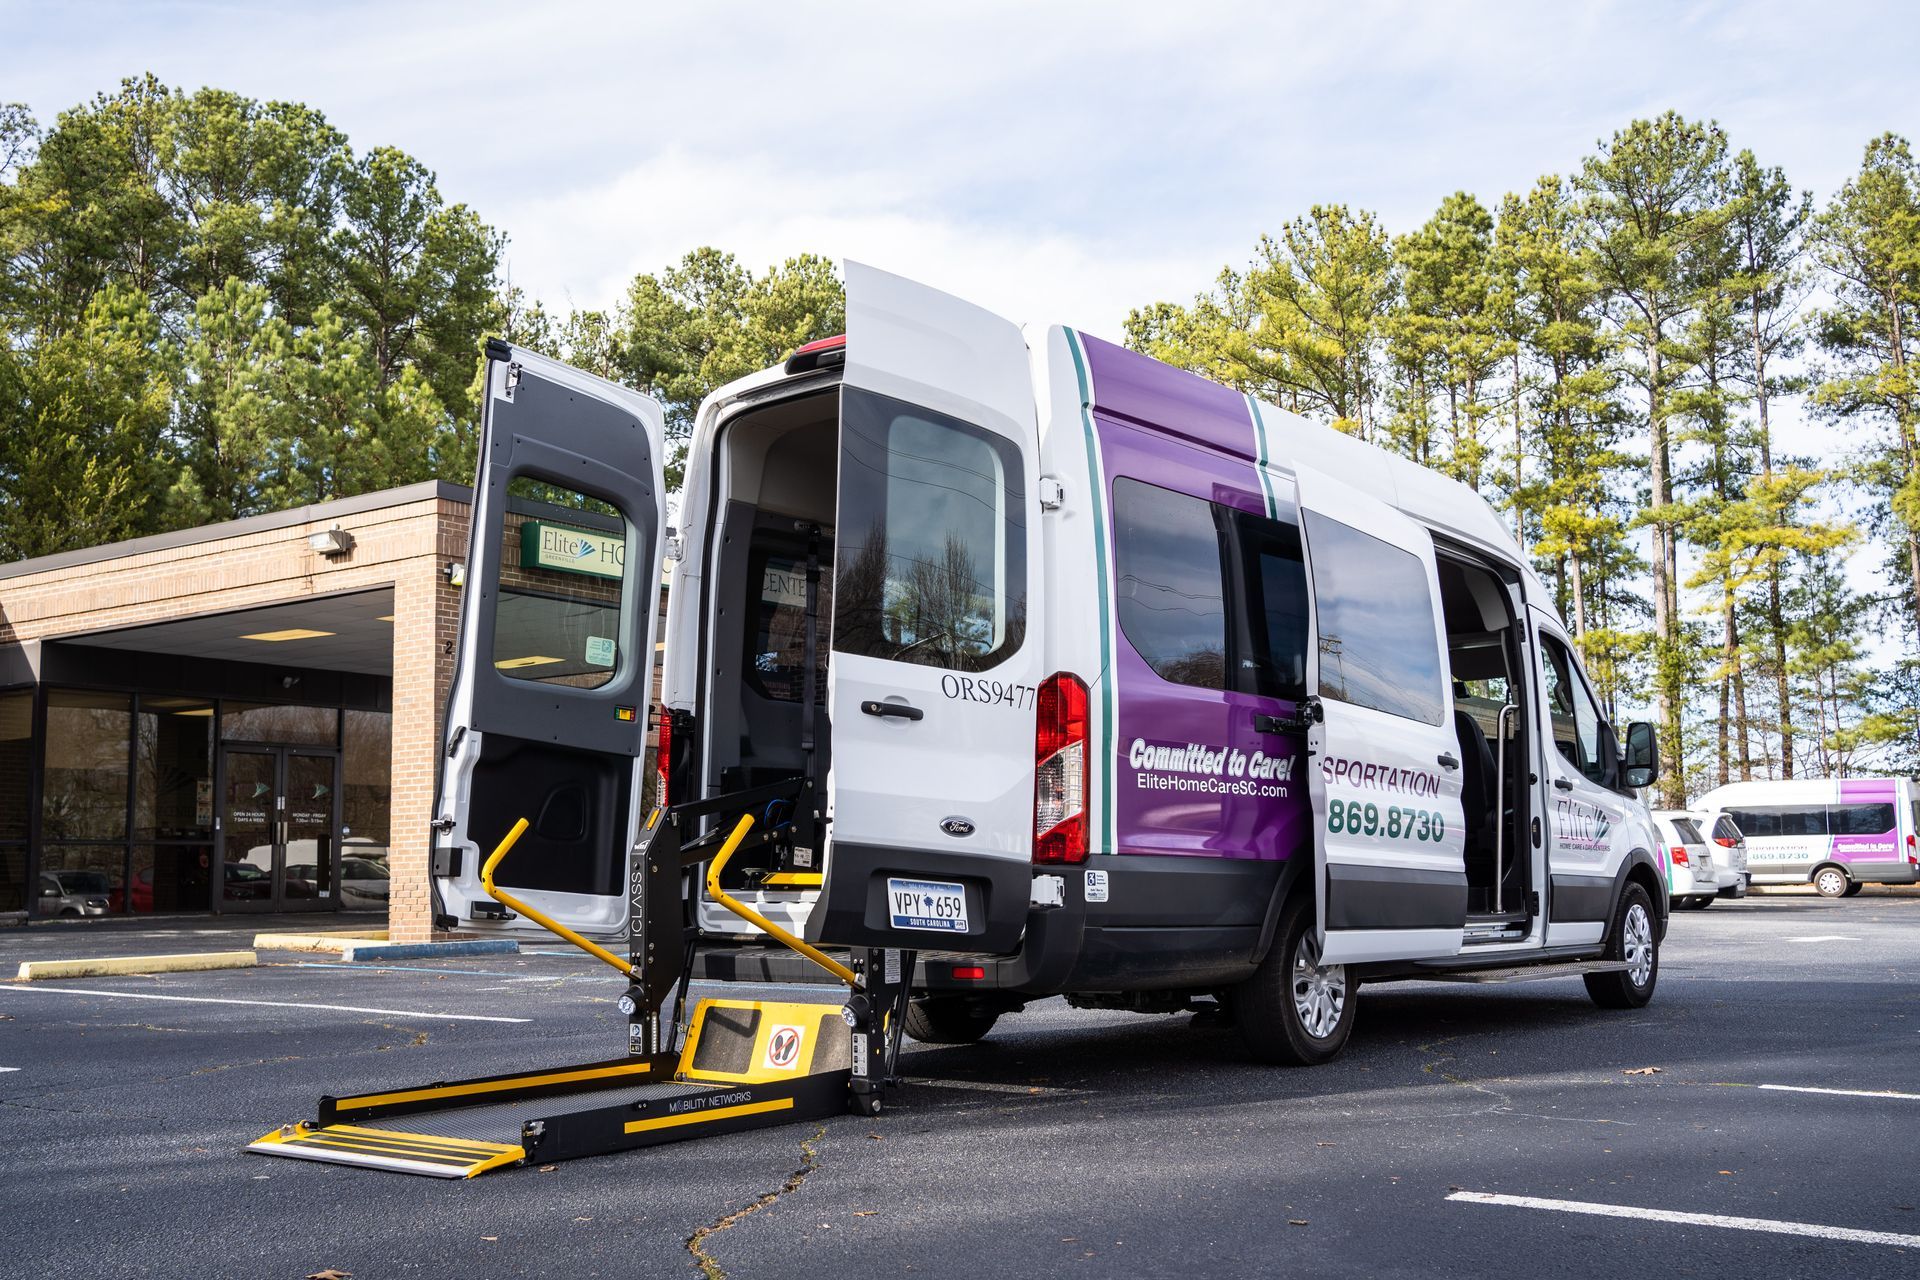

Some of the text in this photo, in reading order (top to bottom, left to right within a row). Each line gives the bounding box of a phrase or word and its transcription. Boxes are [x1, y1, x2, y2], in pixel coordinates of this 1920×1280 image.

[543, 531, 578, 556] Elite
[445, 641, 453, 655] 2
[941, 674, 1035, 711] ORS9477
[1129, 737, 1296, 781] Committed to Care!
[1137, 773, 1288, 798] EliteHomeCareSC.com
[1322, 756, 1441, 799] SPORTATION
[1328, 798, 1445, 843] 869.8730
[1557, 798, 1593, 842] Elite
[1560, 842, 1571, 850] HOME
[1572, 843, 1583, 851] CARE
[895, 891, 961, 918] VPY 659
[909, 918, 951, 928] SOUTH CAROLINA
[709, 1091, 752, 1107] NETWORKS
